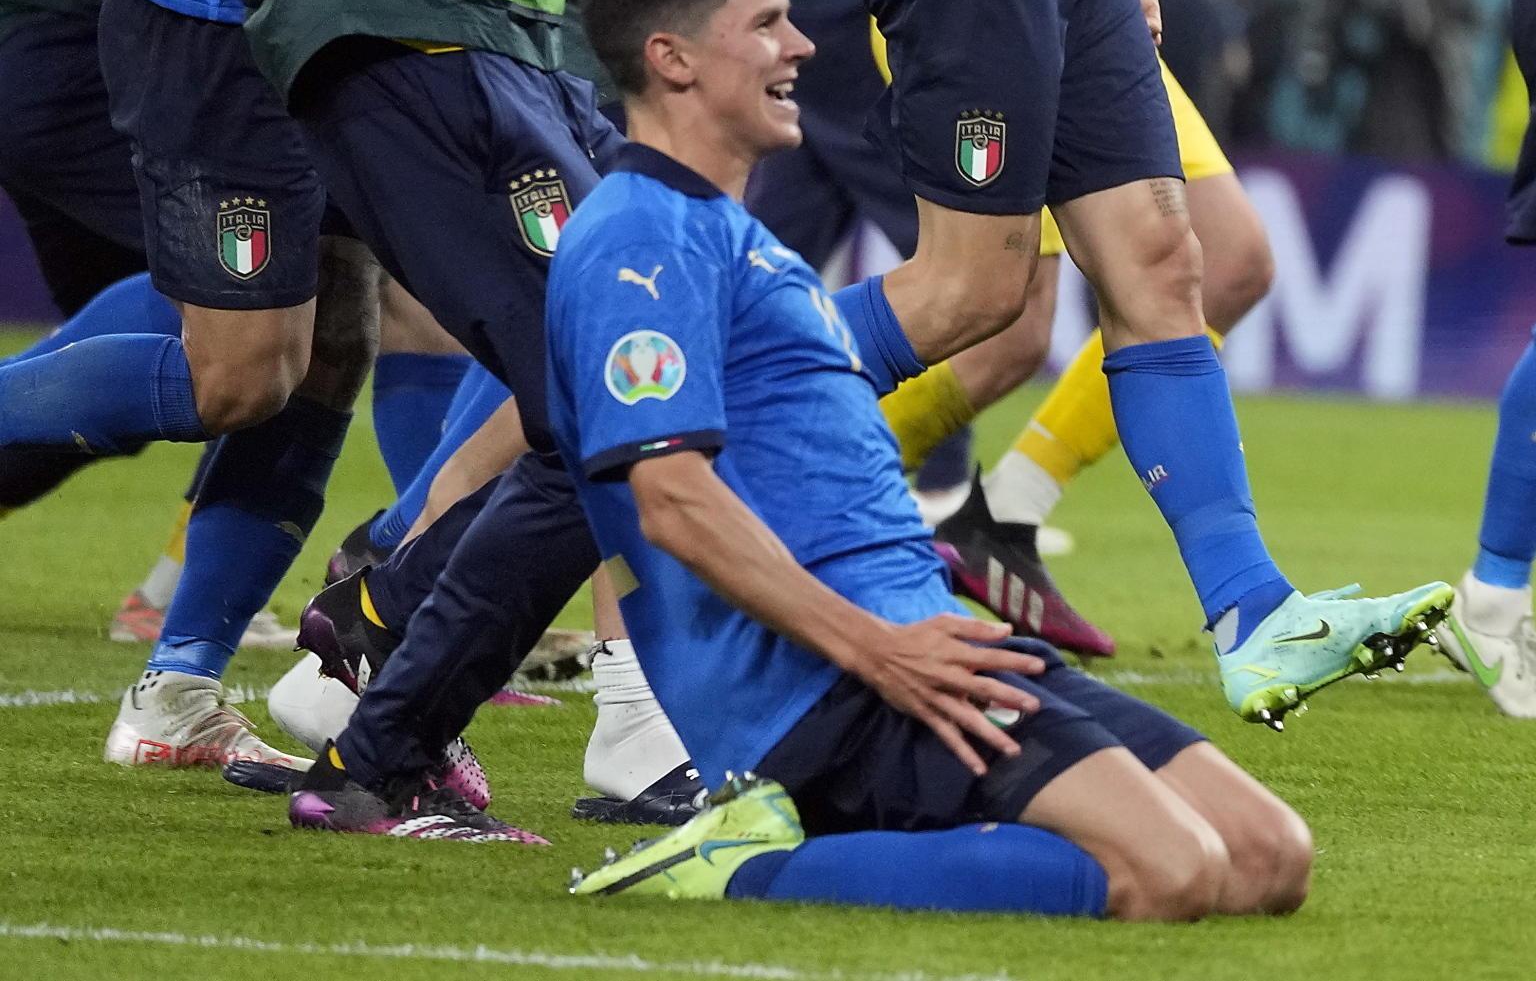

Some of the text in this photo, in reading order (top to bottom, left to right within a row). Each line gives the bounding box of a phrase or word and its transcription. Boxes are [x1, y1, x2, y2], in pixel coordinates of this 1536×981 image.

[961, 124, 1001, 136] ITALIA
[517, 186, 561, 208] ITALIA
[222, 214, 265, 227] ITALIA
